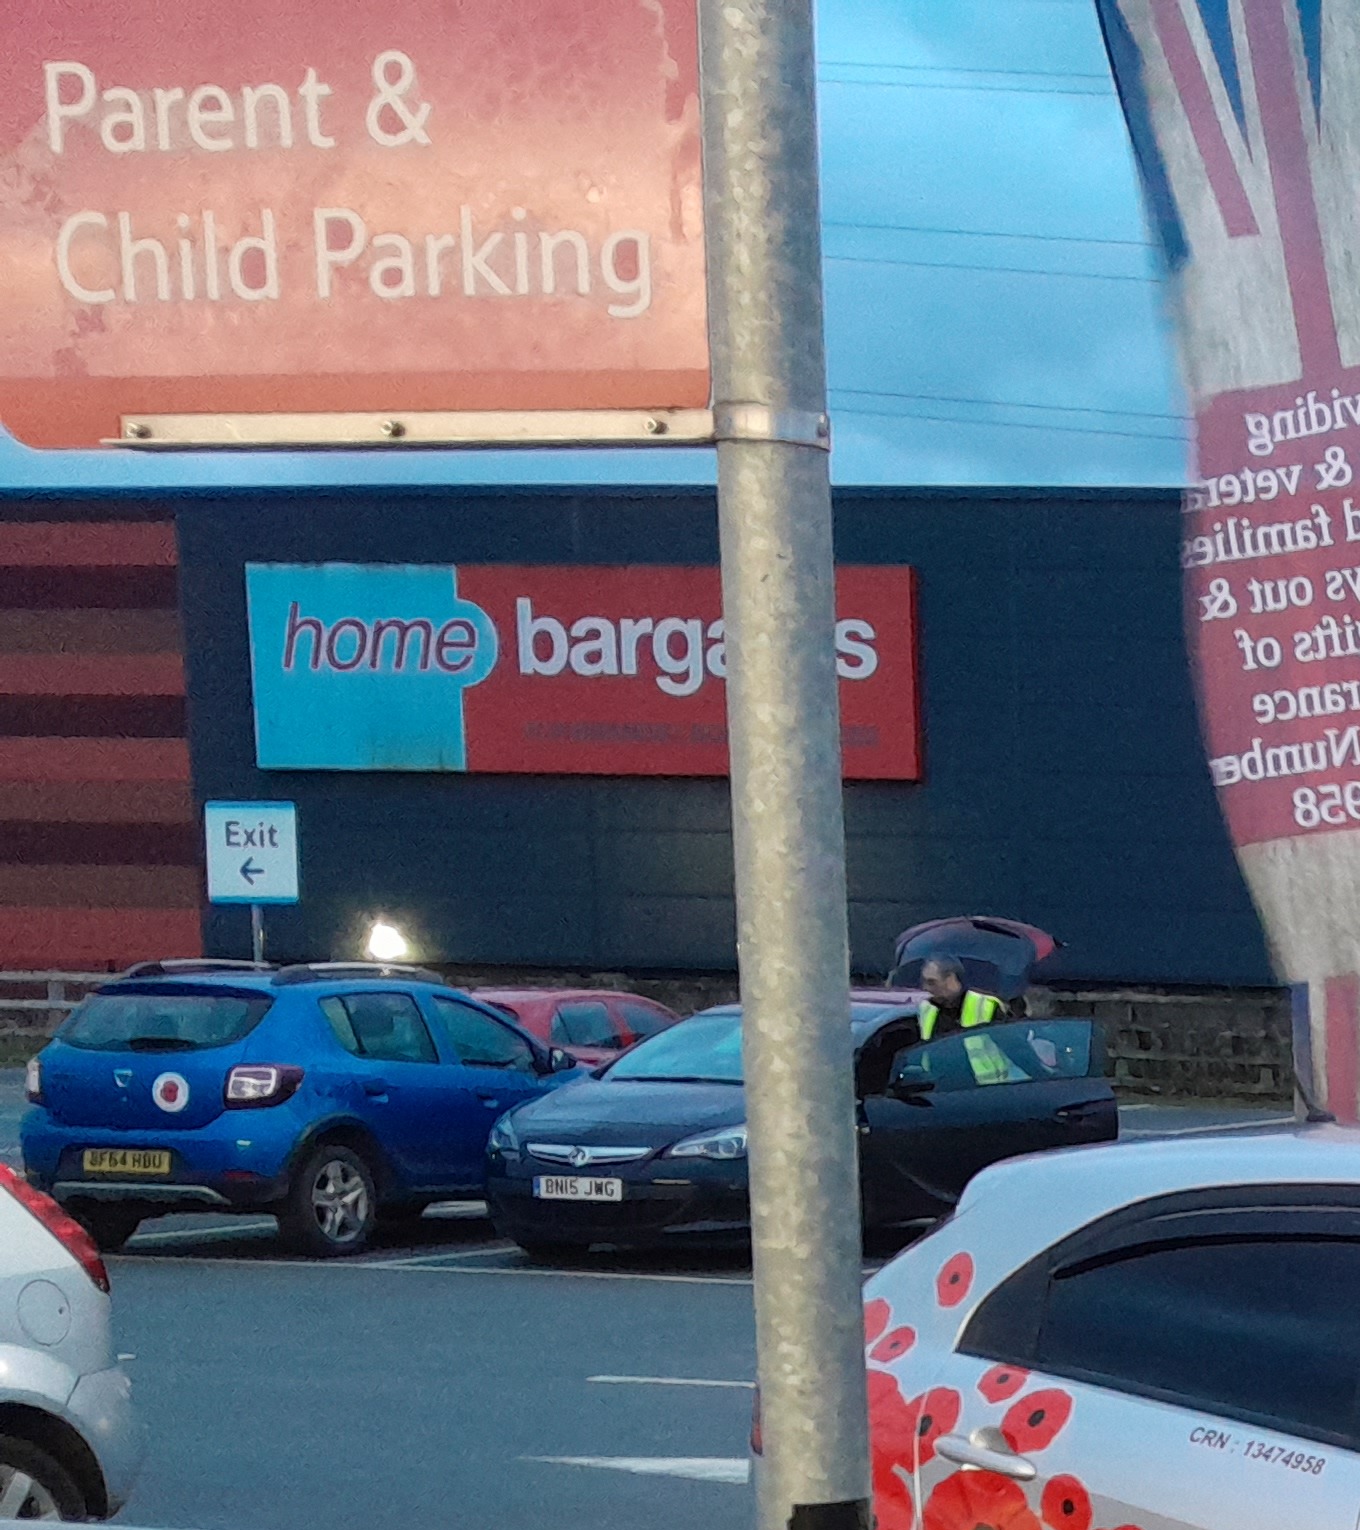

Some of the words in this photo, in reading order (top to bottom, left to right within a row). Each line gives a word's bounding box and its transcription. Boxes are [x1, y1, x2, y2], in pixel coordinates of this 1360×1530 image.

[42, 60, 337, 154] Parent
[364, 48, 433, 148] &
[55, 207, 282, 305] Child
[313, 205, 655, 320] Parking
[281, 602, 480, 672] home
[225, 821, 279, 848] Exit
[1189, 1426, 1232, 1449] CRN
[1243, 1440, 1327, 1476] 13474958
